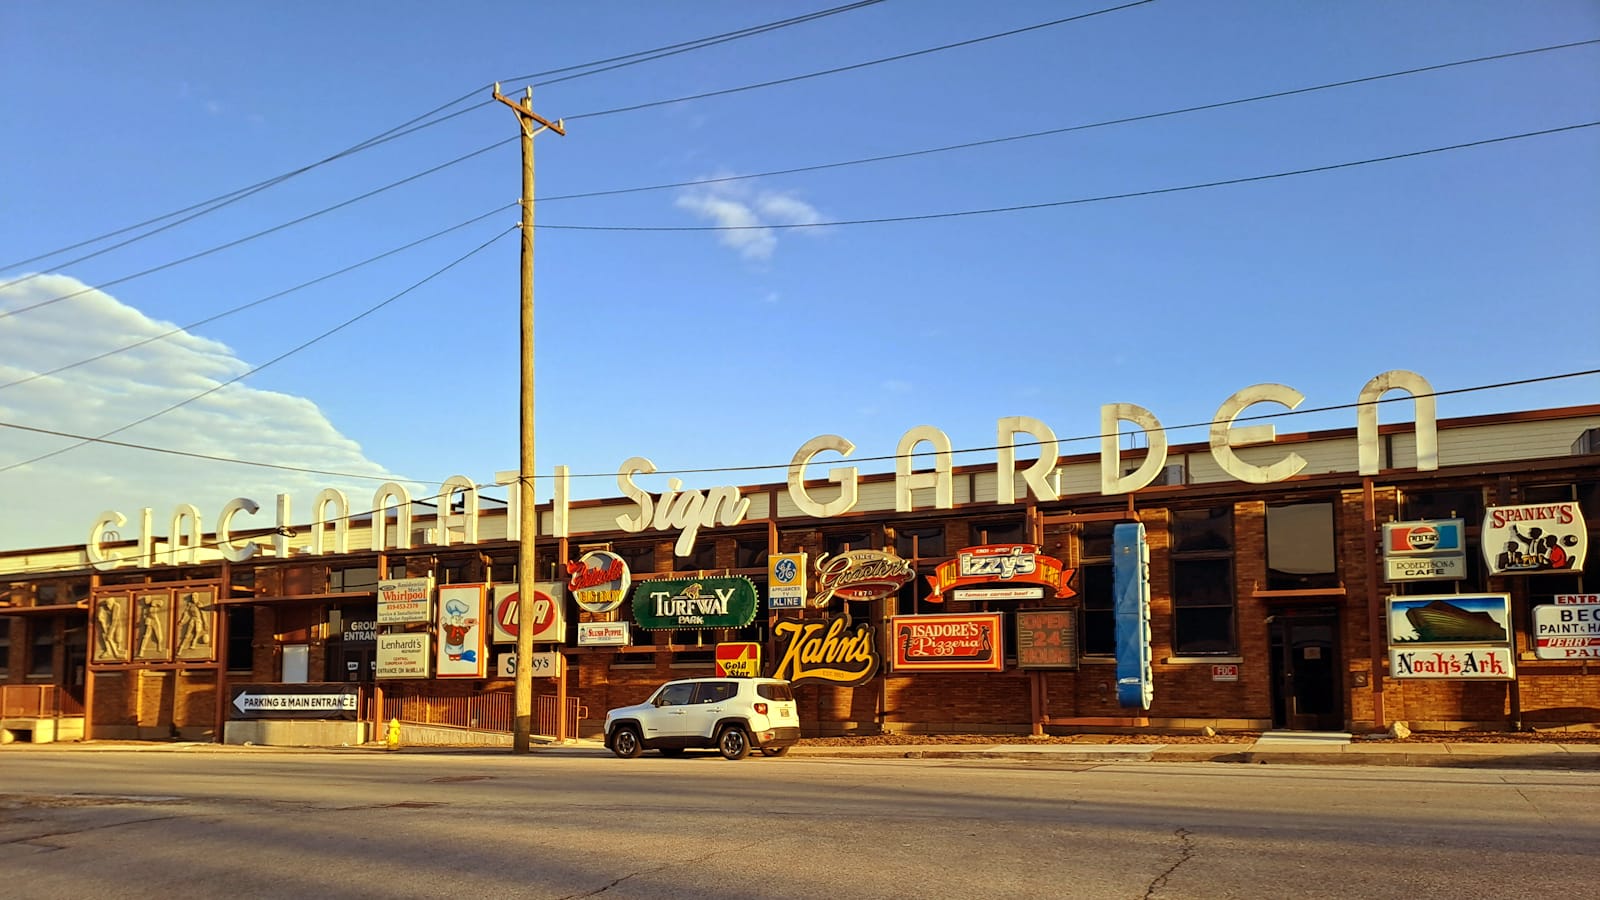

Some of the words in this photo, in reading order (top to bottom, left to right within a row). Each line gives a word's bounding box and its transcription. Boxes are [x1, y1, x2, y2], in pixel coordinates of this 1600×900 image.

[615, 457, 751, 556] Sign
[787, 369, 1439, 518] GARDEN
[1491, 505, 1574, 528] SPANKY'S
[382, 589, 426, 602] Whirlpool
[650, 588, 735, 617] TURFWAY
[678, 616, 704, 625] PARK
[1023, 614, 1070, 629] OPEN
[913, 622, 979, 637] ISADORE'S
[1540, 624, 1579, 634] PAINT
[381, 639, 422, 650] Lenhardt's
[913, 637, 979, 656] Pizzeria
[1033, 631, 1062, 647] 24
[1548, 638, 1591, 648] PERRY
[773, 617, 872, 682] Kahn's
[725, 661, 747, 669] Gold
[1397, 651, 1461, 676] Noah's
[1461, 651, 1507, 675] Ark
[244, 698, 279, 707] PARKING
[280, 698, 286, 707] &
[288, 698, 310, 707] MAIN
[311, 698, 354, 707] ENTRANCE
